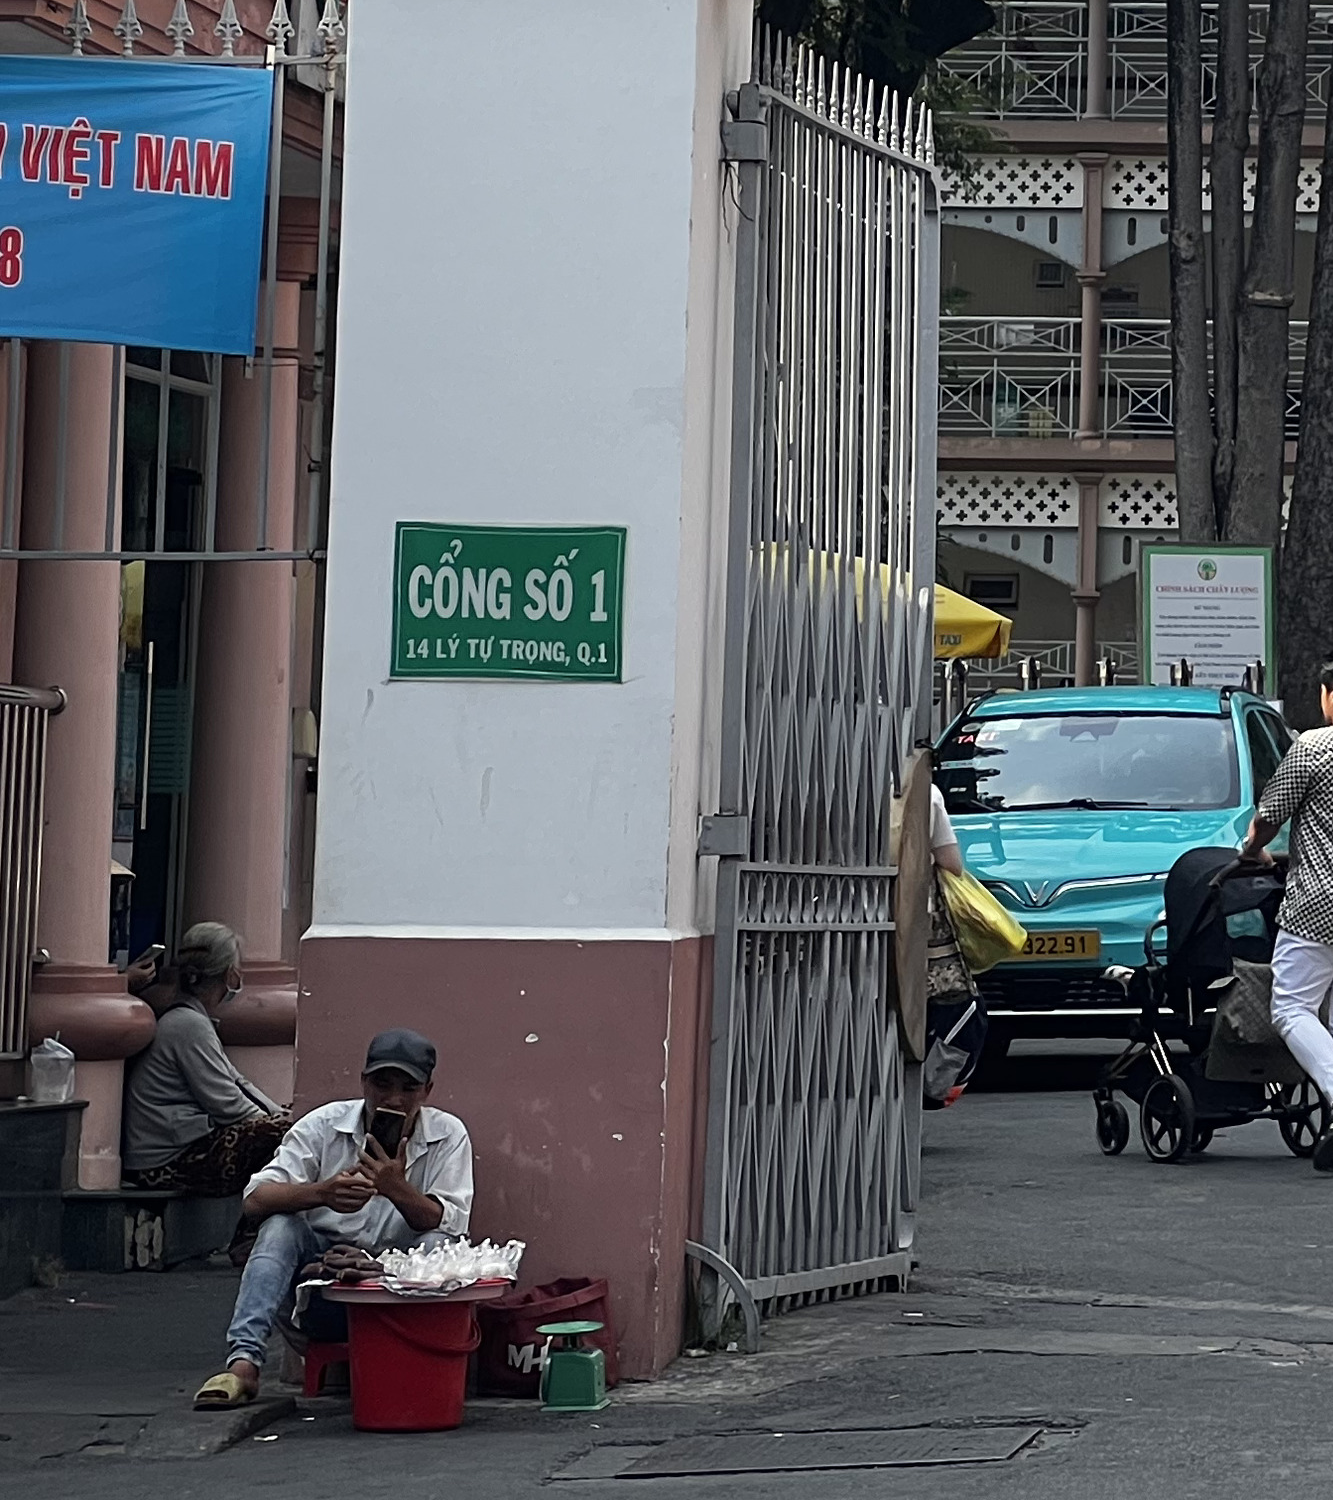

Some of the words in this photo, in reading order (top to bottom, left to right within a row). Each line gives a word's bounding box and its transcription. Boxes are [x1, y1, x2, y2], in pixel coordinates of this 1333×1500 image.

[20, 117, 121, 200] VIỆT
[133, 133, 234, 200] NAM
[408, 539, 512, 621] CỔNG
[523, 548, 580, 622] SỐ
[589, 569, 608, 622] 1
[406, 638, 429, 659] 14
[435, 633, 461, 659] LÝ
[467, 635, 495, 663] TỰ
[499, 639, 571, 667] TRỌNG,
[576, 642, 608, 667] Q.1
[939, 633, 962, 646] TAXI
